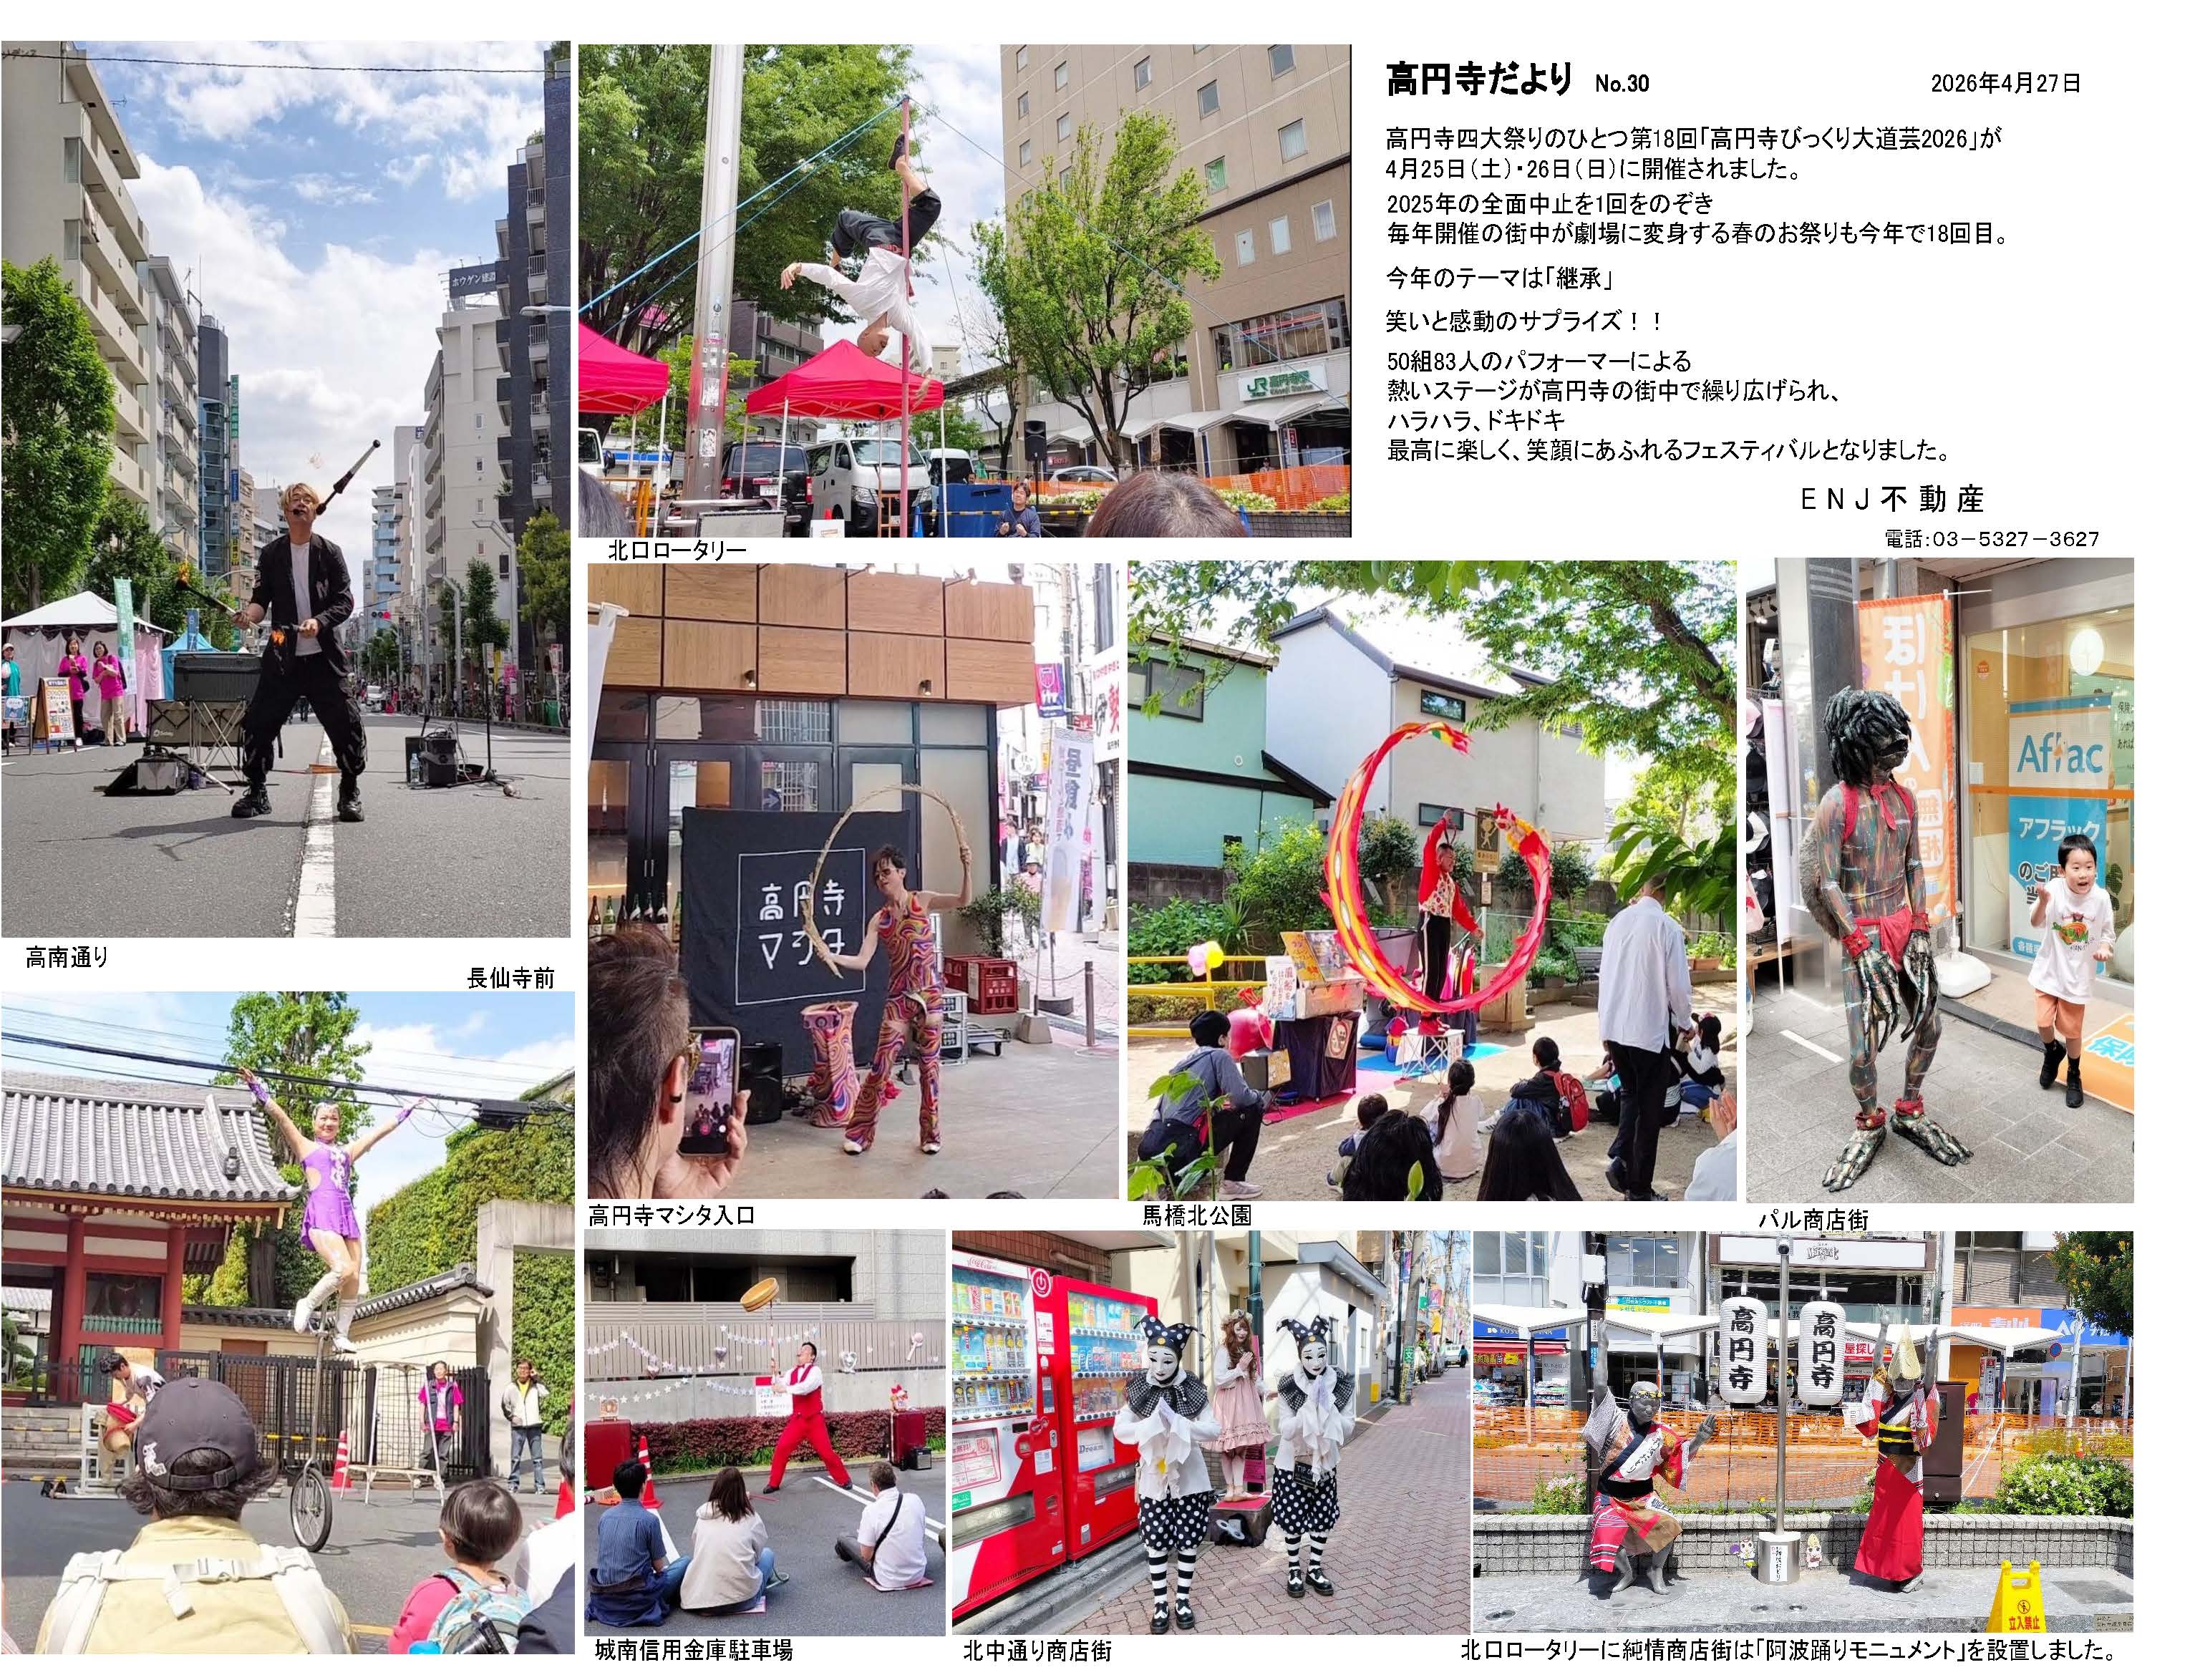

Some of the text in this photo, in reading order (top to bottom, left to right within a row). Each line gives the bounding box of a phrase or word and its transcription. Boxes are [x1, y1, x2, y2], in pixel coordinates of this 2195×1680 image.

[1247, 377, 1268, 392] JR
[1269, 370, 1309, 388] 高円寺駅
[2016, 732, 2104, 774] Aflac
[759, 879, 845, 921] 高円寺
[1729, 1306, 1756, 1391] 高円寺
[1811, 1311, 1838, 1389] 高円寺
[1079, 1443, 1104, 1455] Dream
[2008, 1615, 2040, 1631] 立入禁止
